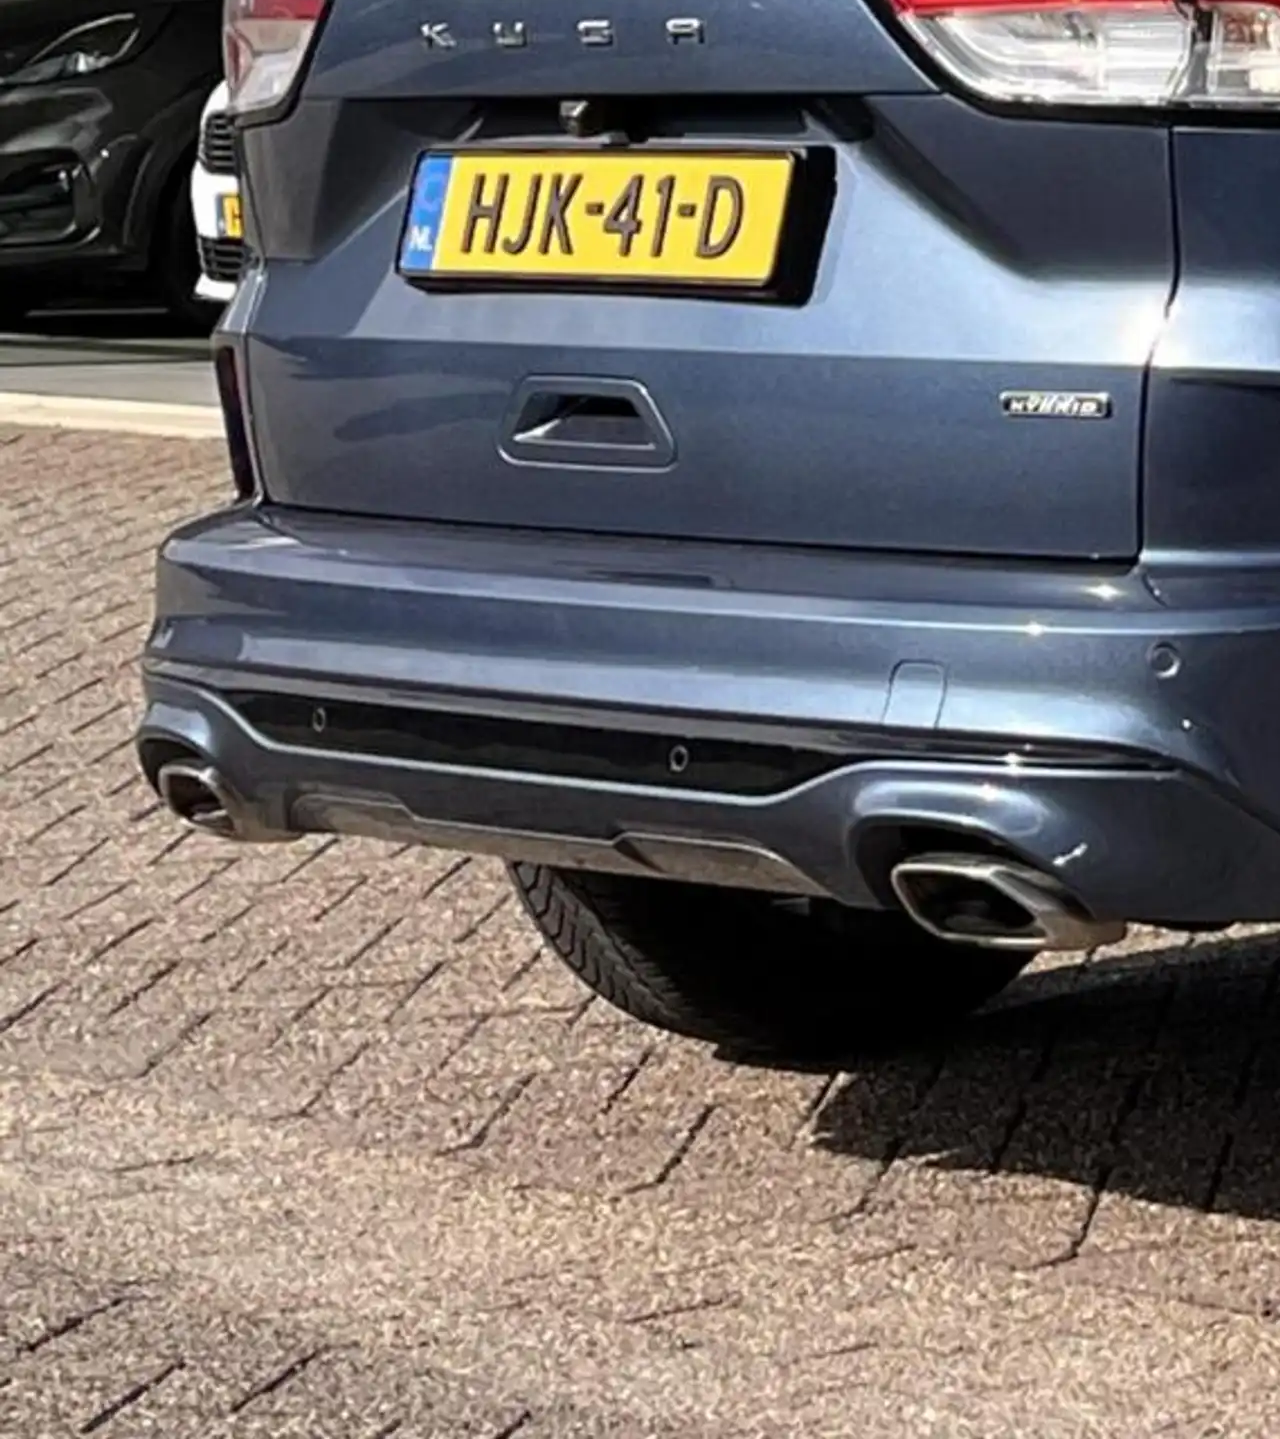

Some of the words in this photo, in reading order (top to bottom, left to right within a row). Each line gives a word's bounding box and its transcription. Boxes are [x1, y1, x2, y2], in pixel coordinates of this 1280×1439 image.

[420, 17, 706, 48] KUGA
[461, 172, 745, 259] HJK-41-D
[407, 225, 433, 251] NL
